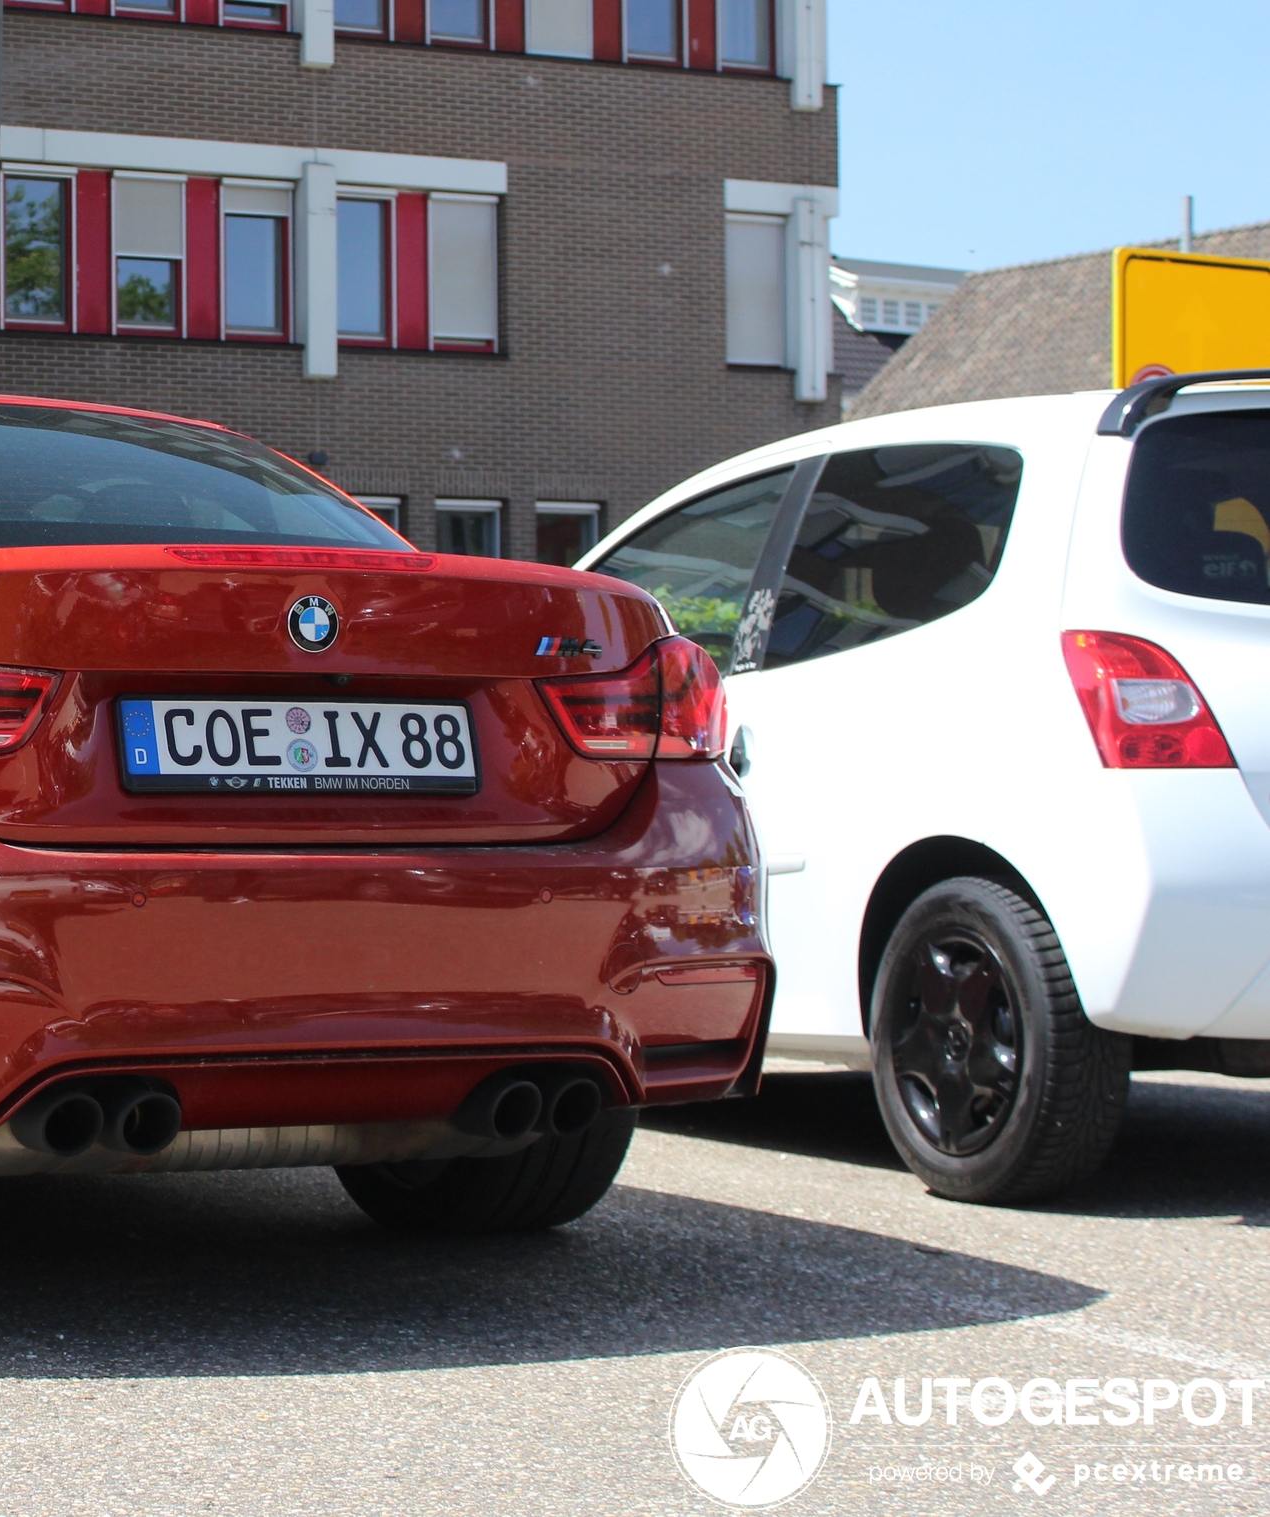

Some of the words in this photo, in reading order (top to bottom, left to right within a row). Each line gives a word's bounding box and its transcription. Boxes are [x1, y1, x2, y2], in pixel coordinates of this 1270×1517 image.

[293, 597, 336, 616] BMW
[554, 637, 603, 660] M4
[164, 708, 282, 766] COE
[323, 711, 390, 768] IX
[400, 712, 466, 769] 88
[134, 748, 148, 764] D
[267, 777, 308, 789] TEKKEN
[314, 777, 343, 789] BMW
[345, 778, 358, 789] IM
[361, 778, 410, 790] NORDEN
